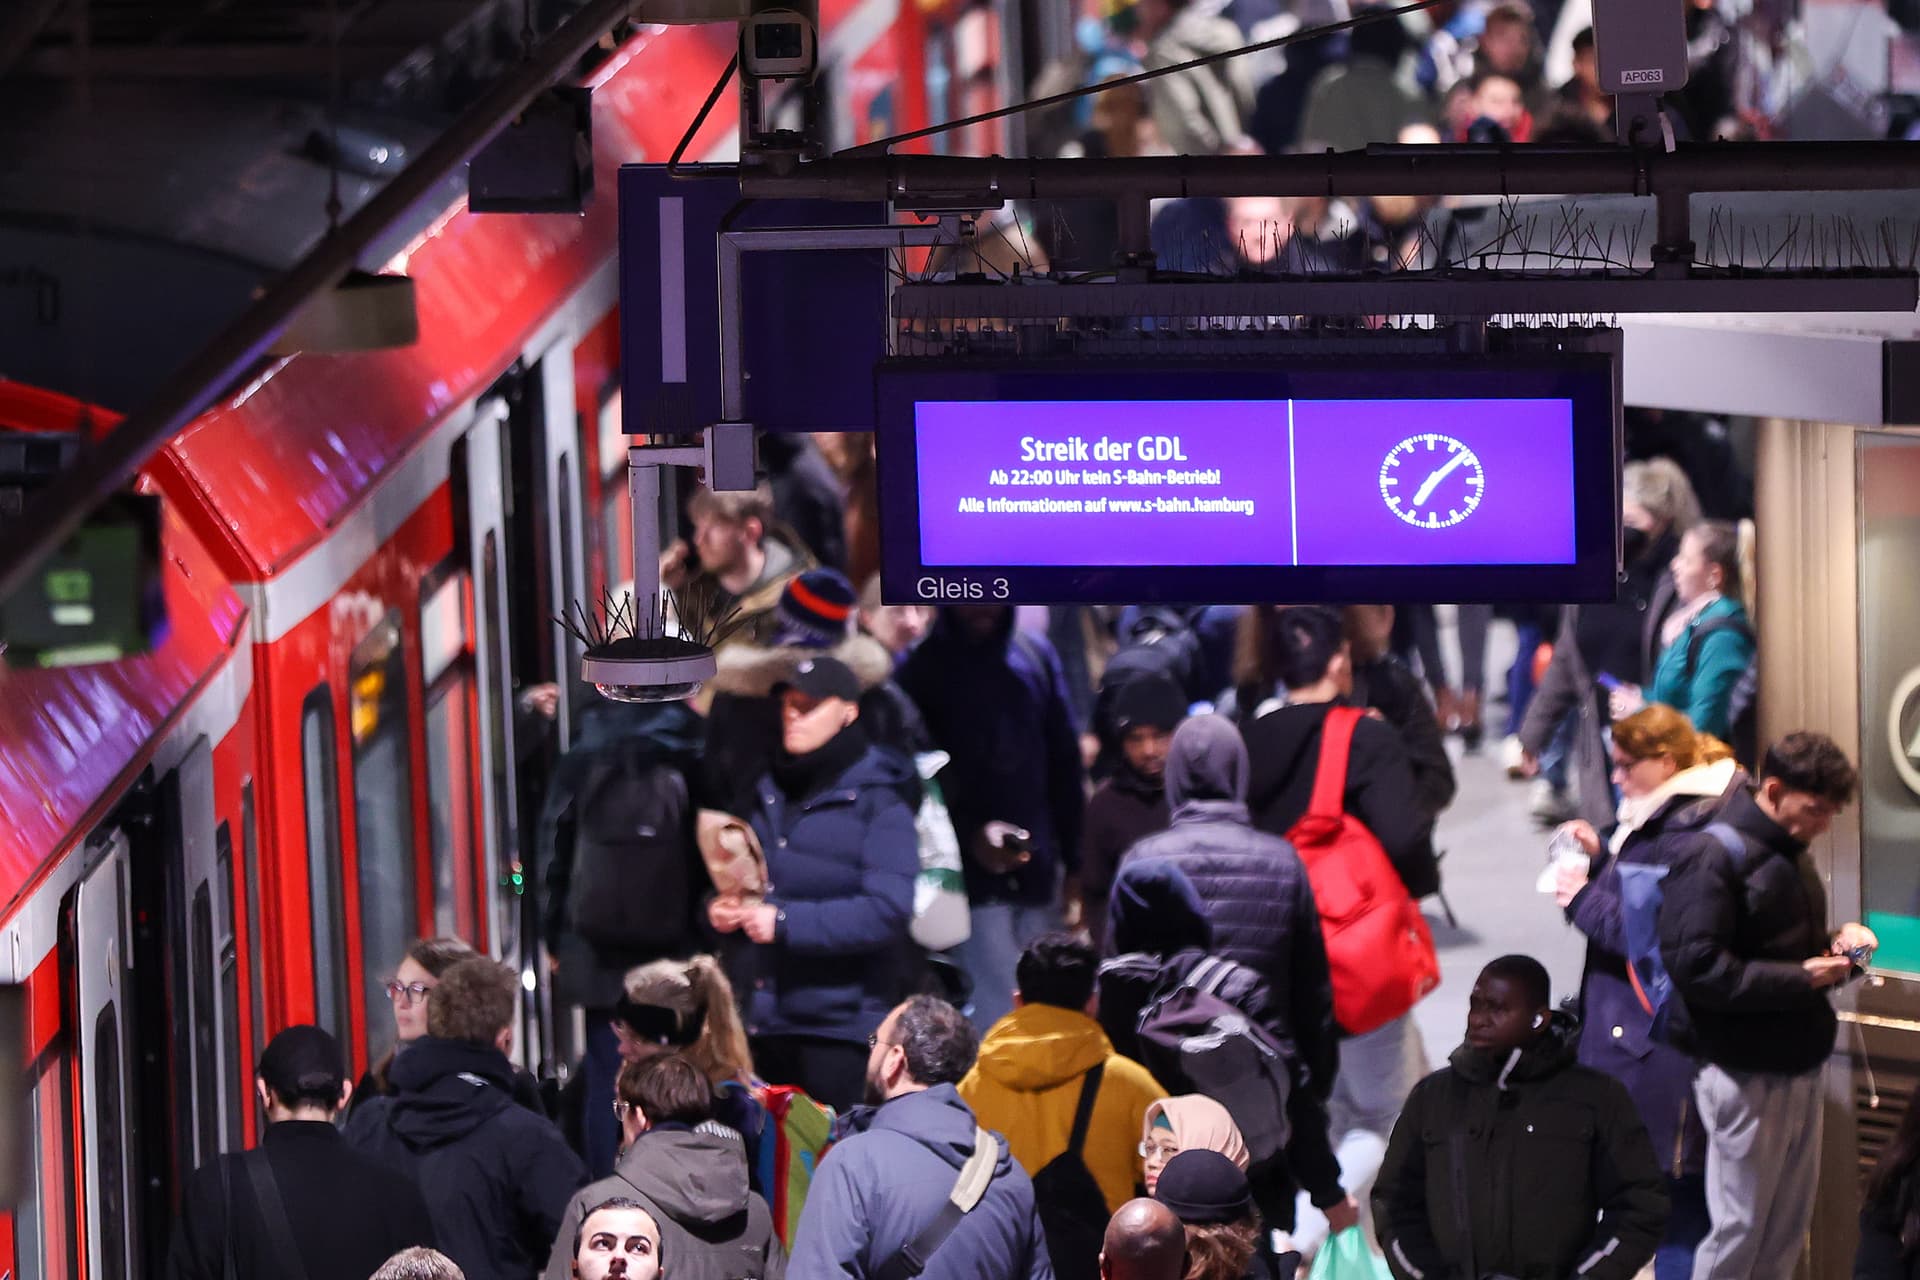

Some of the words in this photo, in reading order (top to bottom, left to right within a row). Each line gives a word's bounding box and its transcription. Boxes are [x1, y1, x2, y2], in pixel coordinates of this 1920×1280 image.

[1624, 71, 1661, 82] AP063
[1020, 437, 1089, 462] Streik
[1093, 436, 1132, 461] der
[1137, 436, 1188, 461] GDL
[989, 470, 1008, 485] Ab
[1010, 469, 1053, 485] 22:00
[1055, 469, 1081, 485] Uhr
[1082, 469, 1111, 485] kein
[1113, 469, 1221, 485] S-Bahn-Betrieb!
[958, 497, 985, 513] Alle
[987, 497, 1083, 513] Informationen
[1084, 496, 1107, 513] auf
[1108, 496, 1255, 516] www.s-bahn.hamburg
[917, 577, 984, 599] Gleis
[992, 577, 1010, 599] 3
